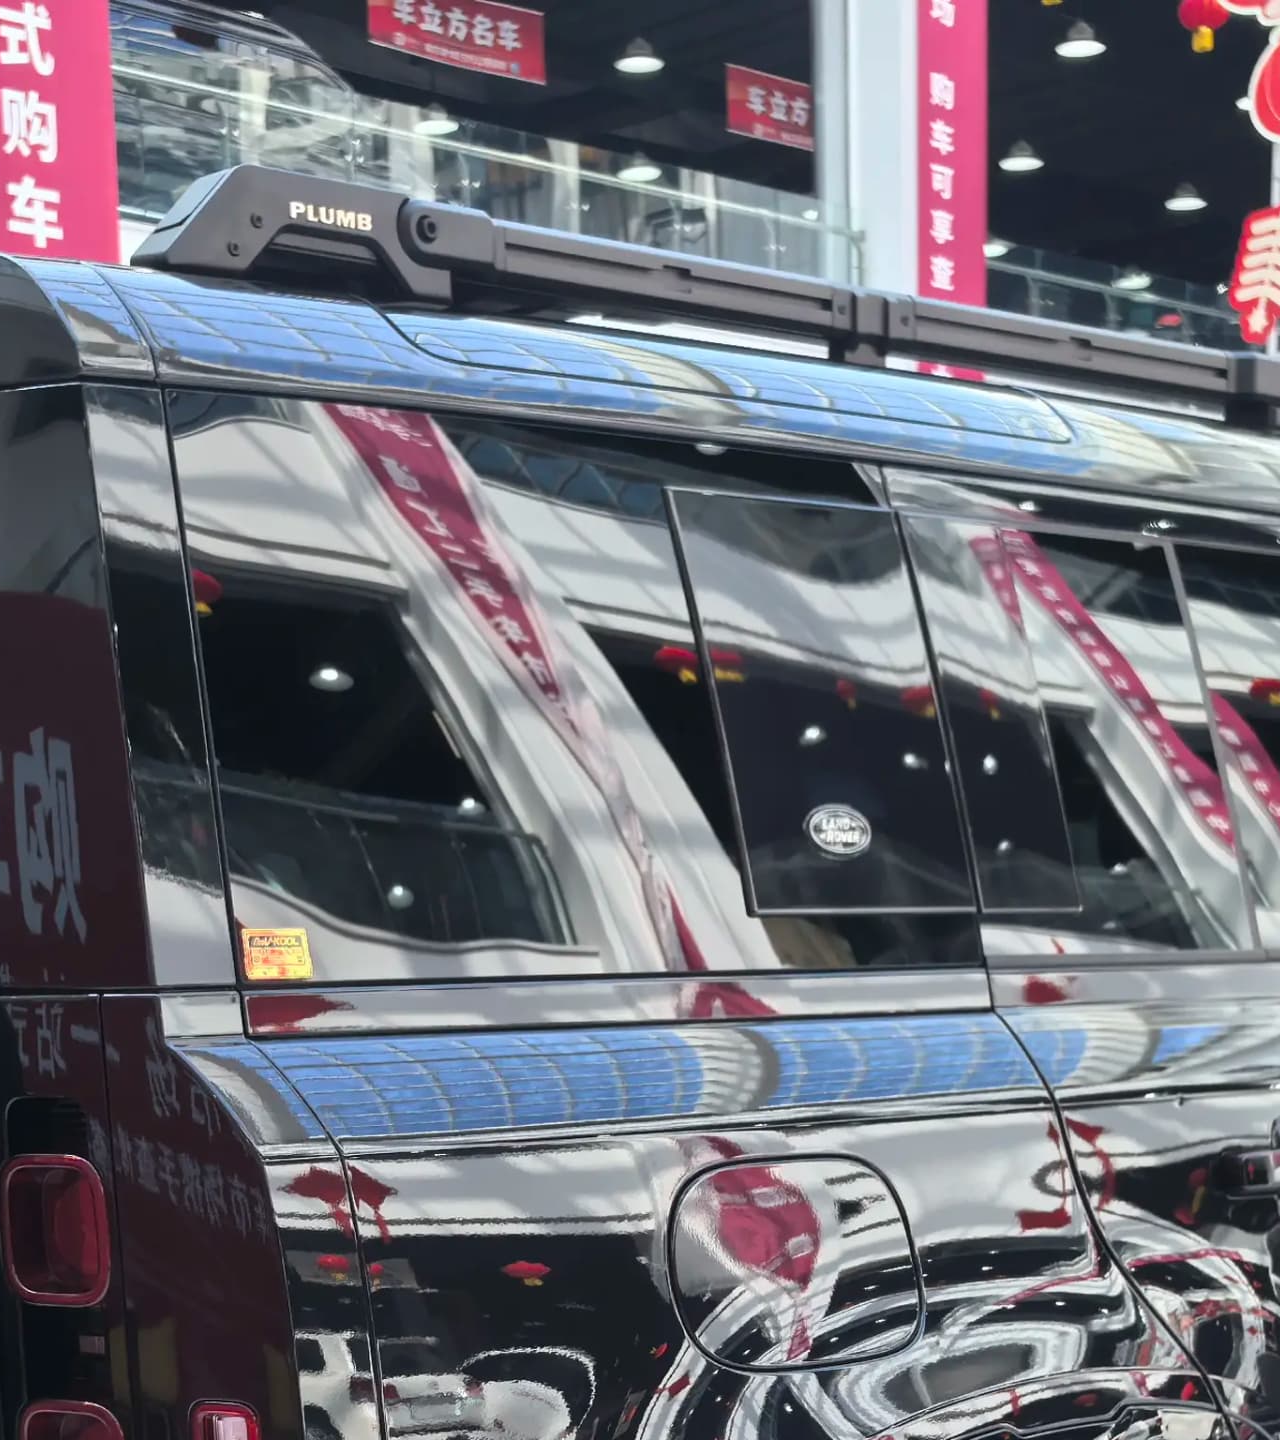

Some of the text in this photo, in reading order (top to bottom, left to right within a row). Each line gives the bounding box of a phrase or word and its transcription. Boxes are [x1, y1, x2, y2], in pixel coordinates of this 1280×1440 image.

[289, 200, 373, 231] PLUMB
[929, 71, 956, 378] 购车可享查
